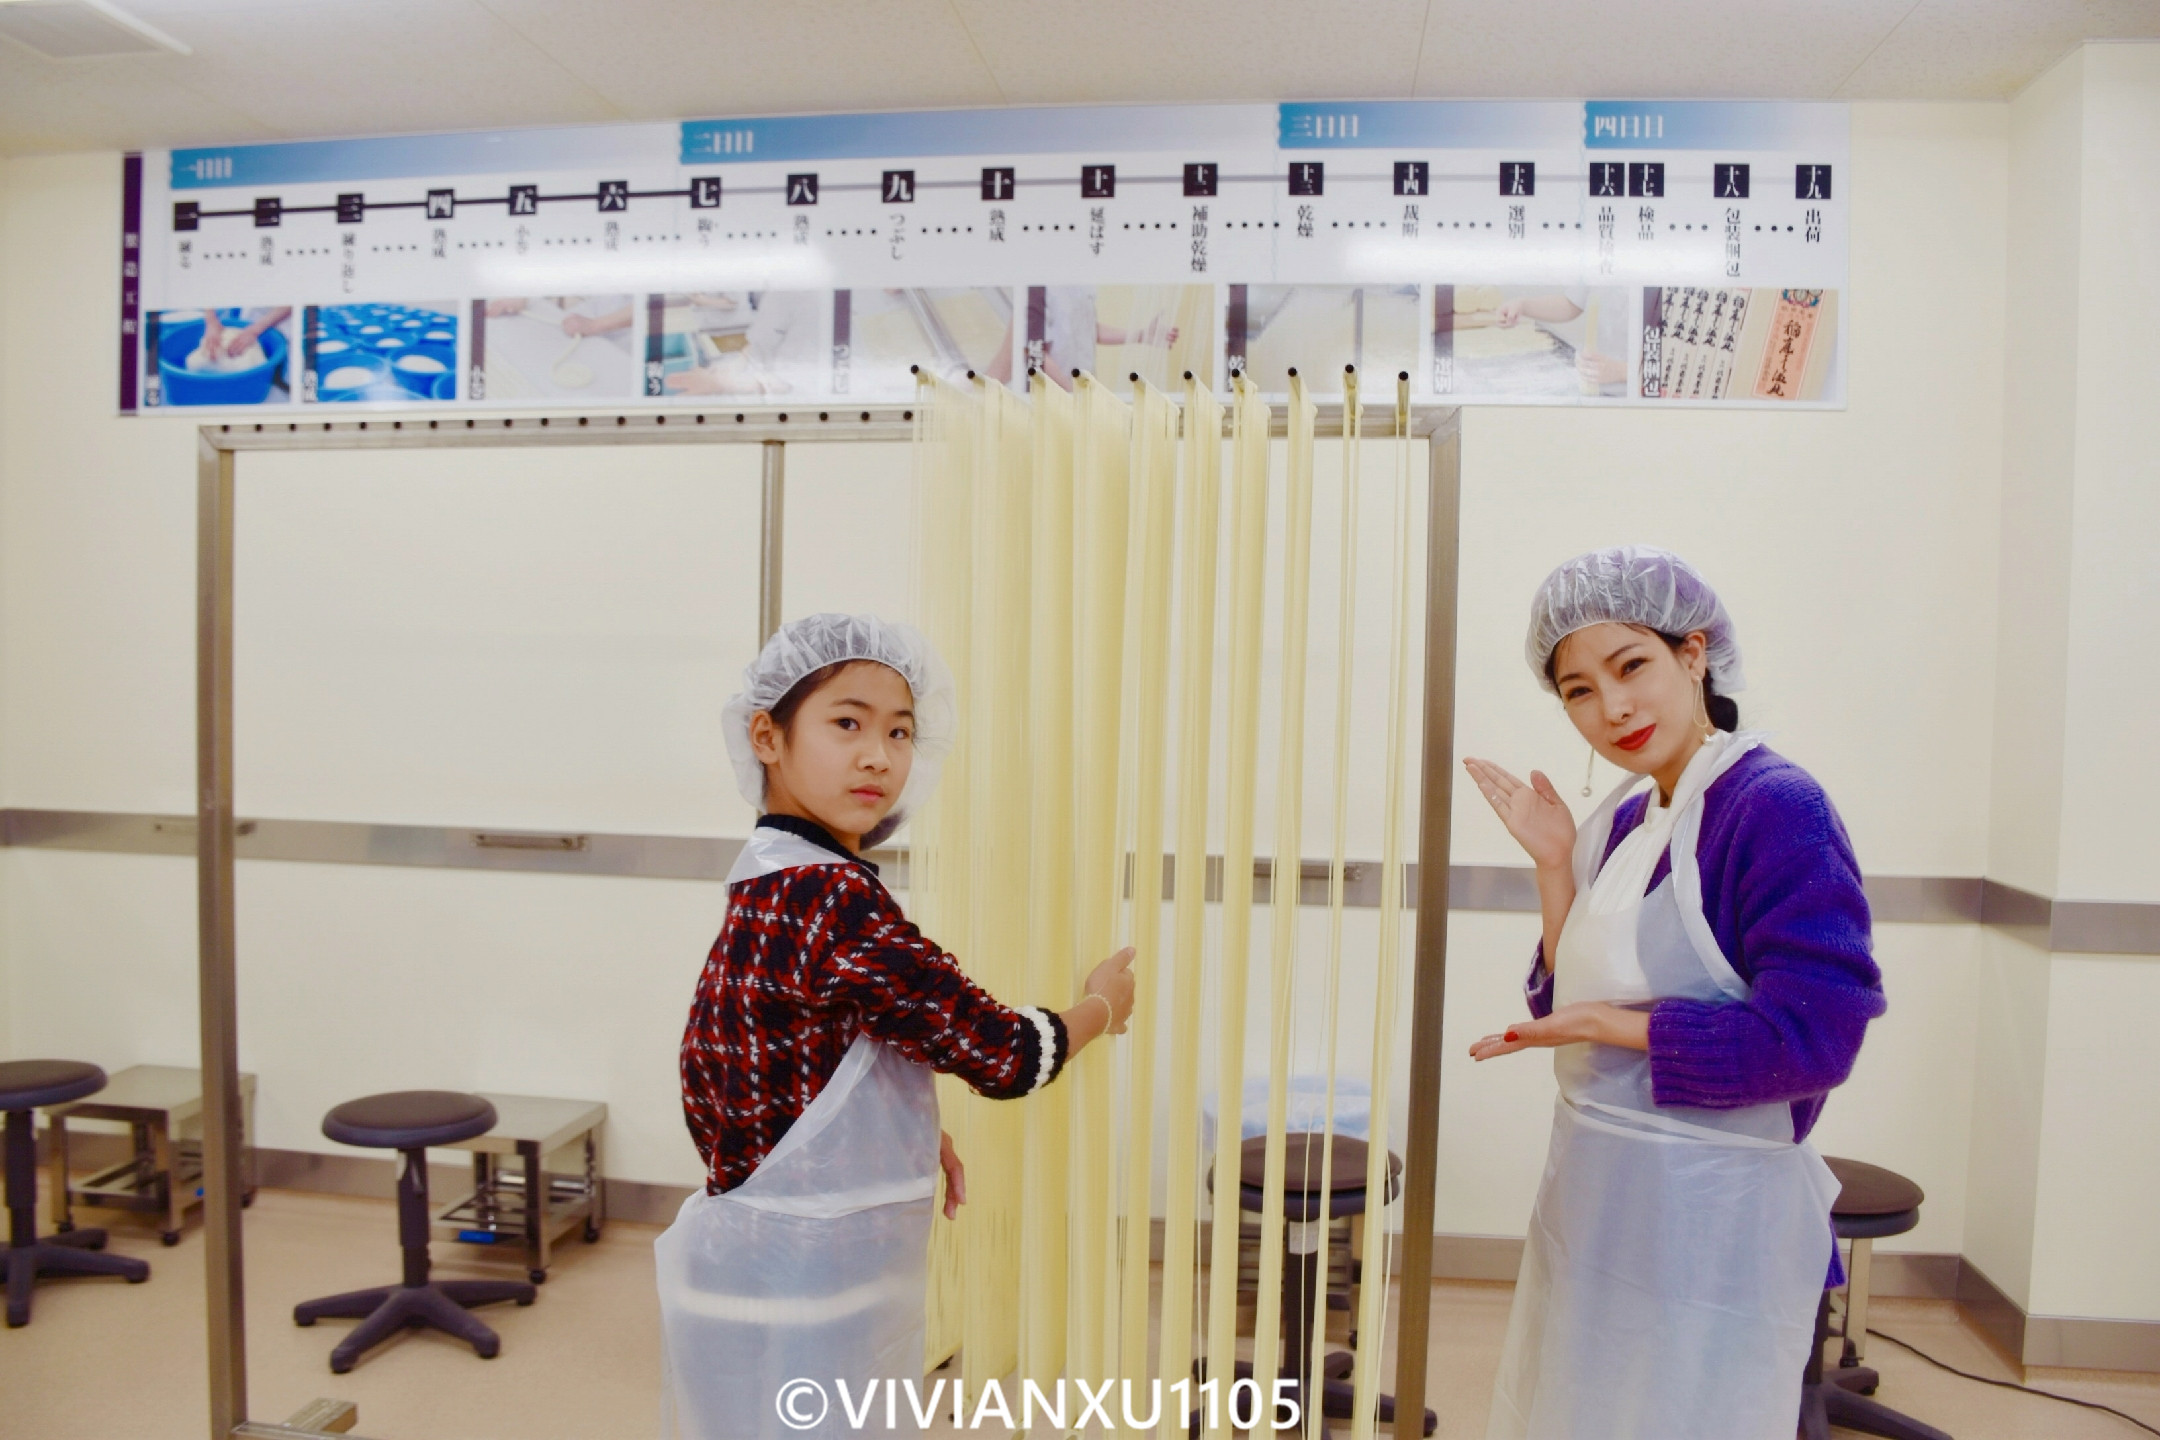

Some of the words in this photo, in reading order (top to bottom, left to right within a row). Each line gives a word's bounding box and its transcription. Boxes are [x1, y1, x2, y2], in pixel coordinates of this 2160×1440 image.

[1290, 115, 1358, 138] 三日目
[1595, 116, 1663, 138] 四日目
[692, 180, 718, 206] 七
[789, 178, 815, 203] 八
[885, 173, 912, 201] 九
[984, 170, 1012, 199] 十
[1402, 163, 1420, 194] 十四
[1508, 163, 1526, 194] 十五
[1599, 163, 1616, 195] 十六
[1638, 163, 1655, 196] 十七
[1723, 165, 1740, 197] 十八
[1805, 165, 1822, 198] 十九
[339, 197, 362, 220] 三
[428, 193, 452, 217] 四
[513, 188, 536, 213] 五
[601, 183, 625, 209] 六
[257, 201, 279, 223] 二
[1297, 204, 1314, 239] 乾燥
[1402, 204, 1419, 239] 裁断
[1508, 204, 1525, 239] 選別
[1638, 206, 1655, 241] 検品
[1805, 208, 1821, 243] 出荷
[889, 214, 905, 260] つぶし
